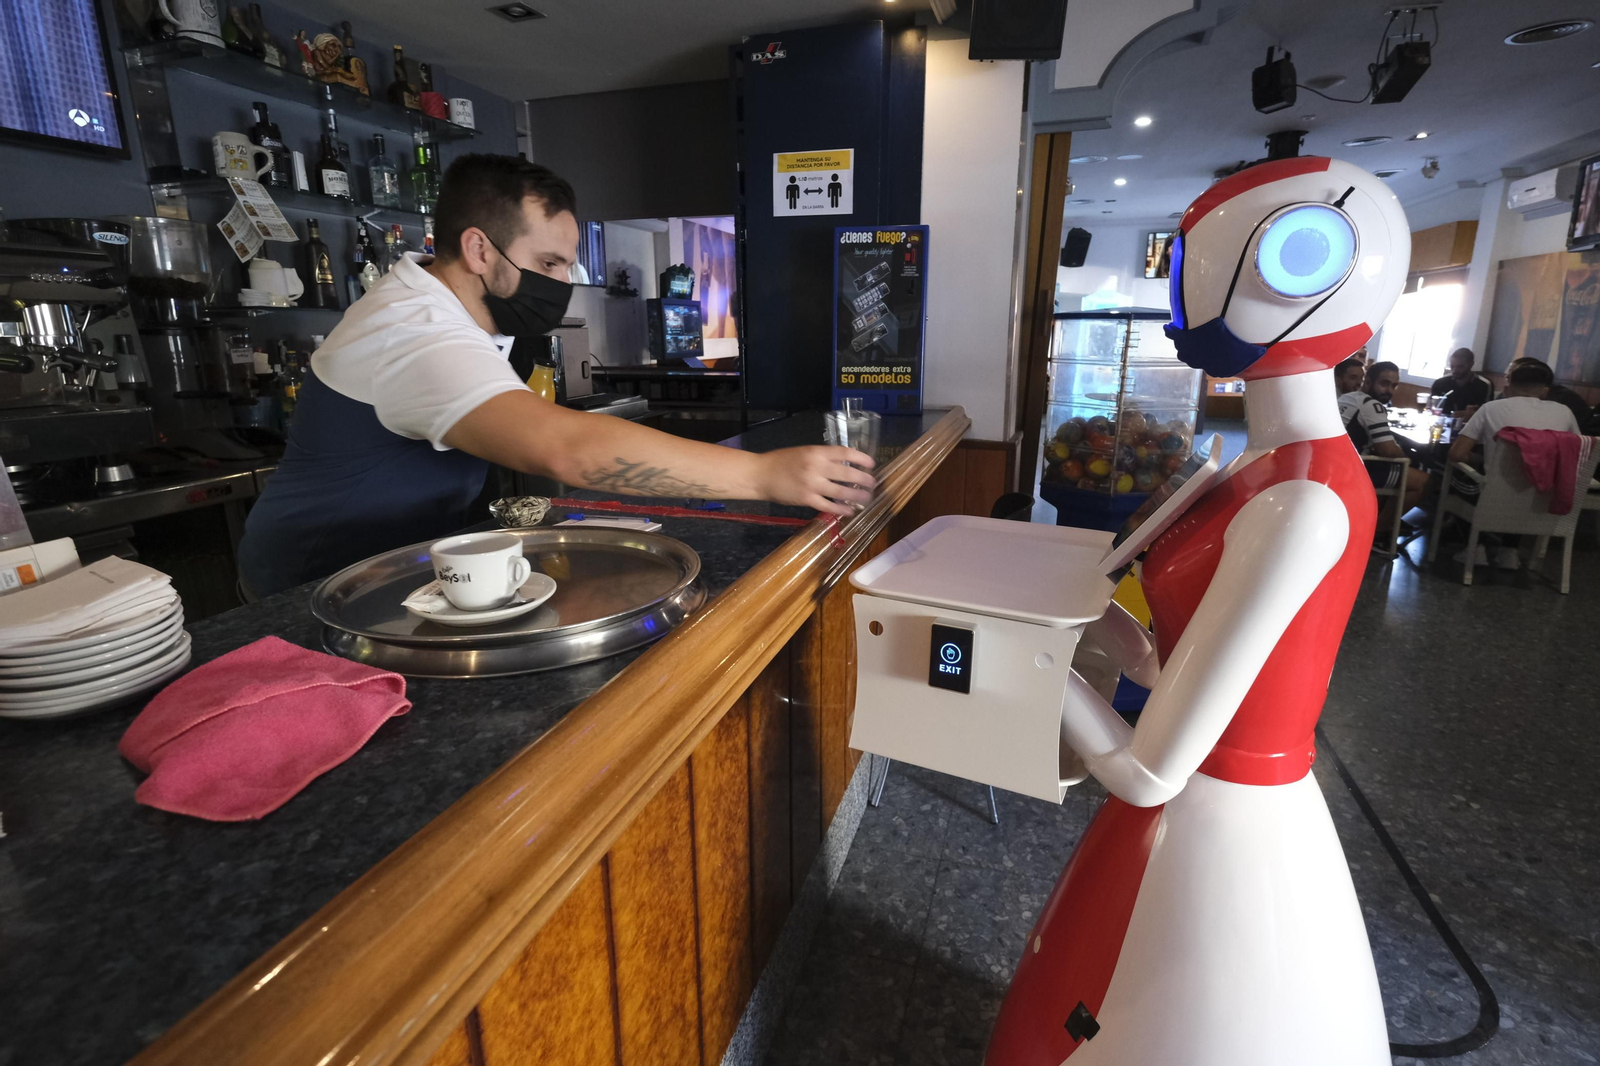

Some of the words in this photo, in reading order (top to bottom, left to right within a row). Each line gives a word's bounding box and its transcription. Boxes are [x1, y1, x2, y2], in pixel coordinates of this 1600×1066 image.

[752, 51, 785, 60] DAS
[840, 232, 873, 244] ¿tienes
[876, 231, 906, 245] fuego?
[864, 248, 880, 258] quality
[880, 248, 894, 258] lighter
[841, 374, 855, 384] 50
[939, 664, 962, 675] EXIT
